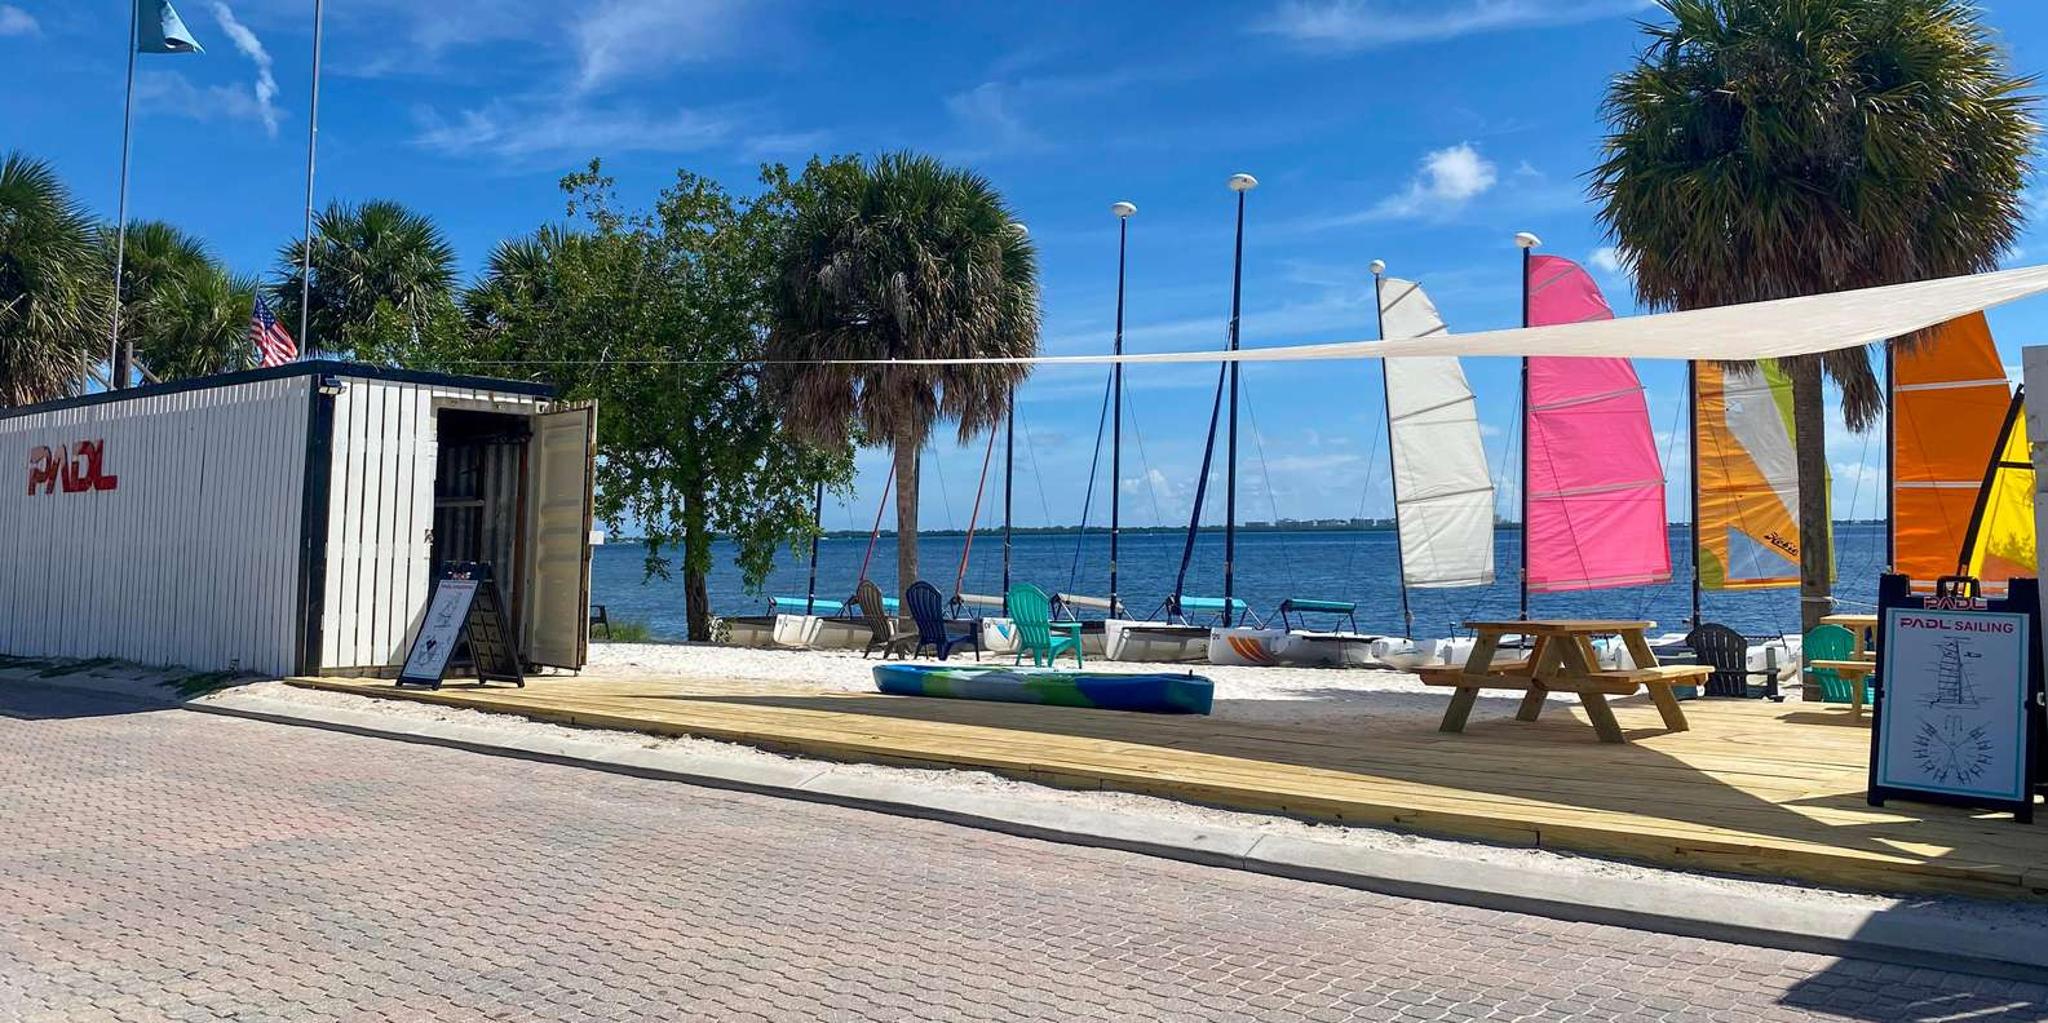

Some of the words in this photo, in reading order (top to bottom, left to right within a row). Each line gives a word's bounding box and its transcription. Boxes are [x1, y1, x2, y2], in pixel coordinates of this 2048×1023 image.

[27, 438, 118, 496] PADL
[1924, 596, 1988, 610] PADL
[1900, 617, 1951, 630] PADL
[1954, 620, 2014, 634] SAILING
